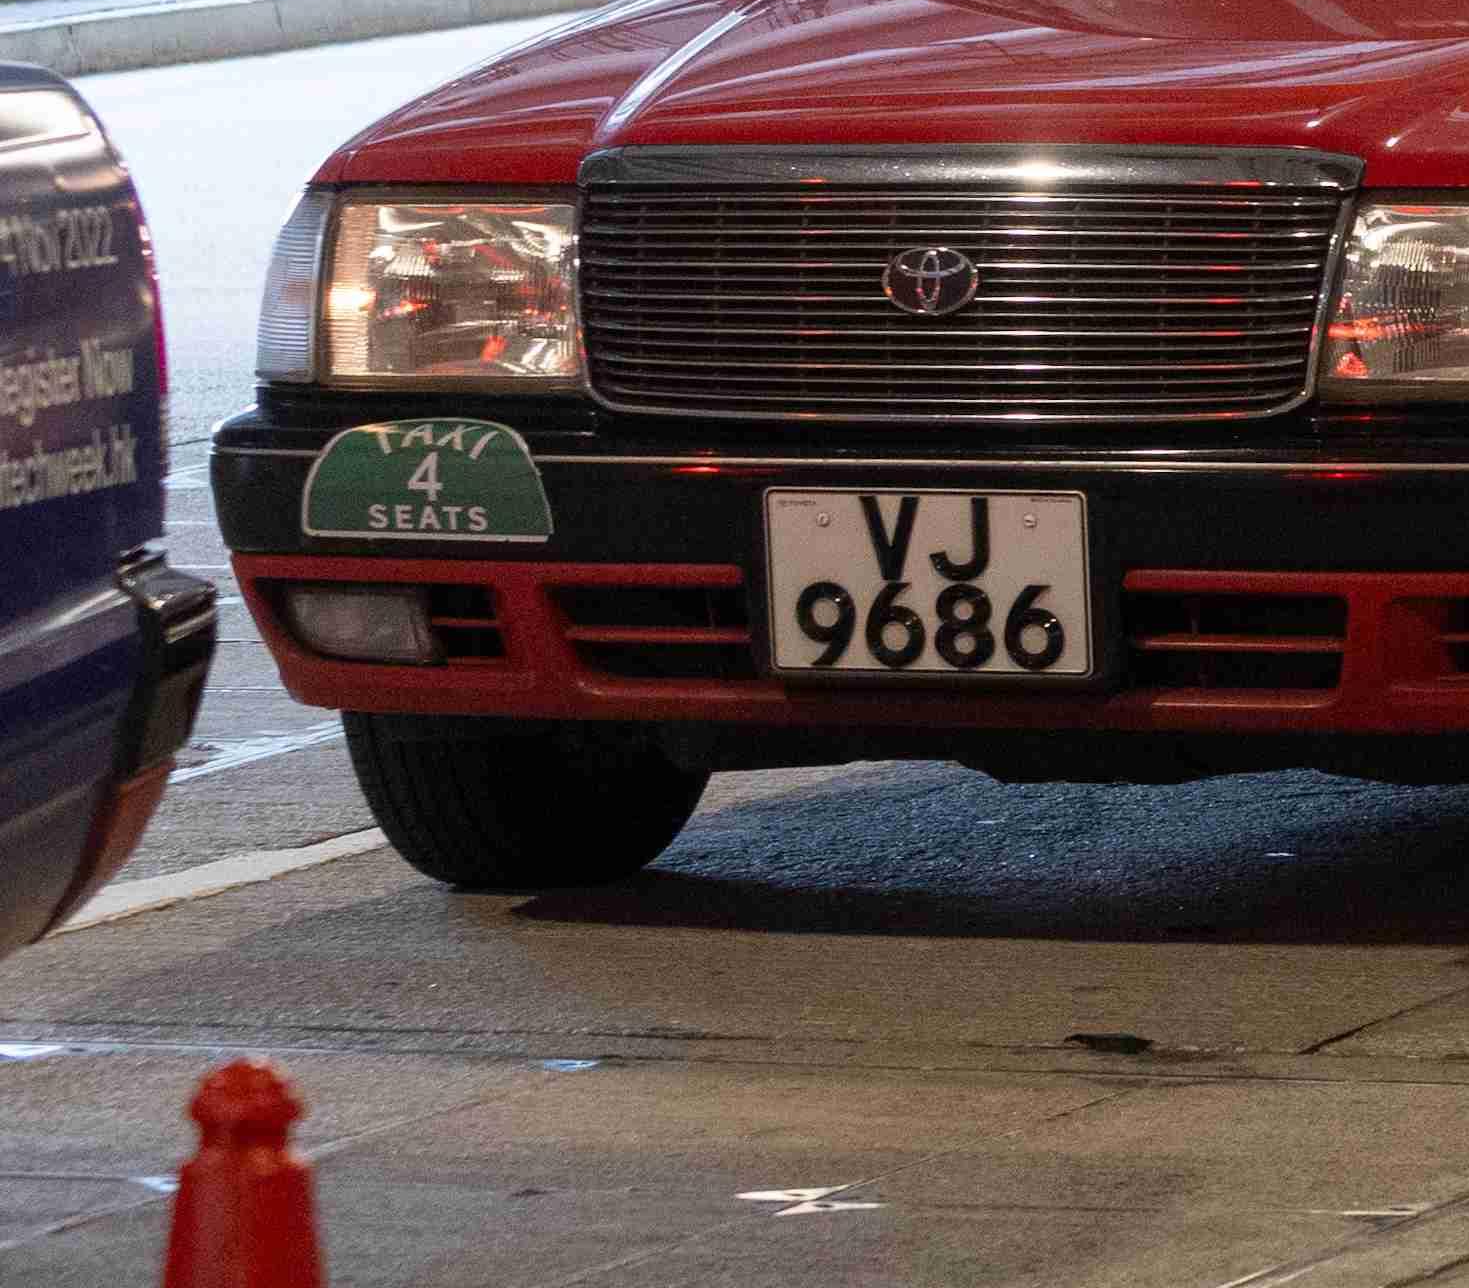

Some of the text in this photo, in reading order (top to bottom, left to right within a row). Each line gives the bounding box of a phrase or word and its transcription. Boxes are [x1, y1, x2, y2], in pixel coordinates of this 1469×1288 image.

[407, 451, 443, 502] 4
[368, 504, 490, 532] SEATS
[859, 495, 991, 581] VJ
[796, 581, 1065, 671] 9686
